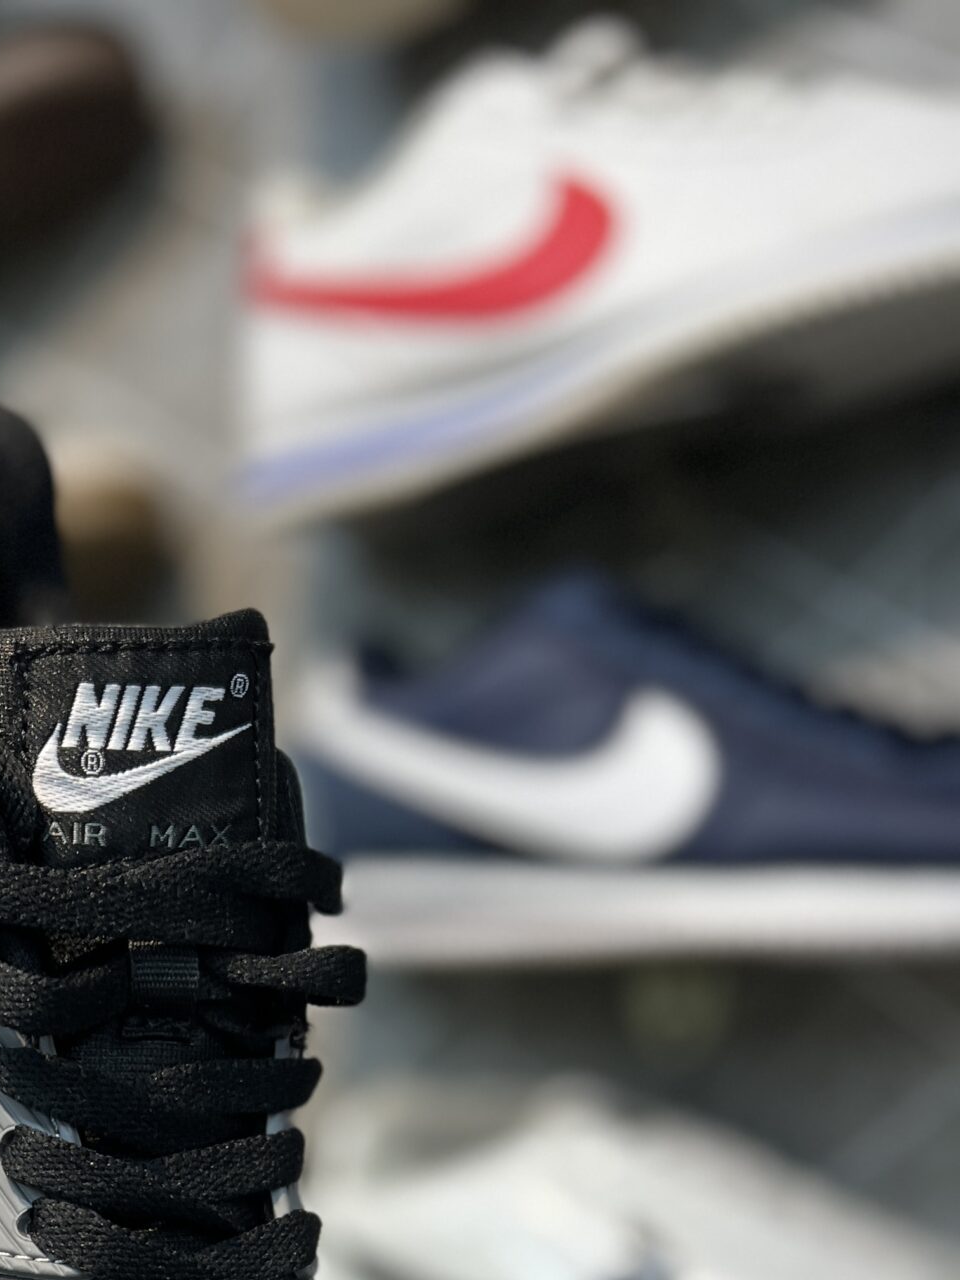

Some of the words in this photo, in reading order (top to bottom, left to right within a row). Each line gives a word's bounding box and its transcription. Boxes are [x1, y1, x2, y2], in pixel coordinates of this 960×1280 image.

[61, 682, 226, 752] NIKE
[43, 821, 108, 847] AIR
[149, 824, 232, 849] MAX
